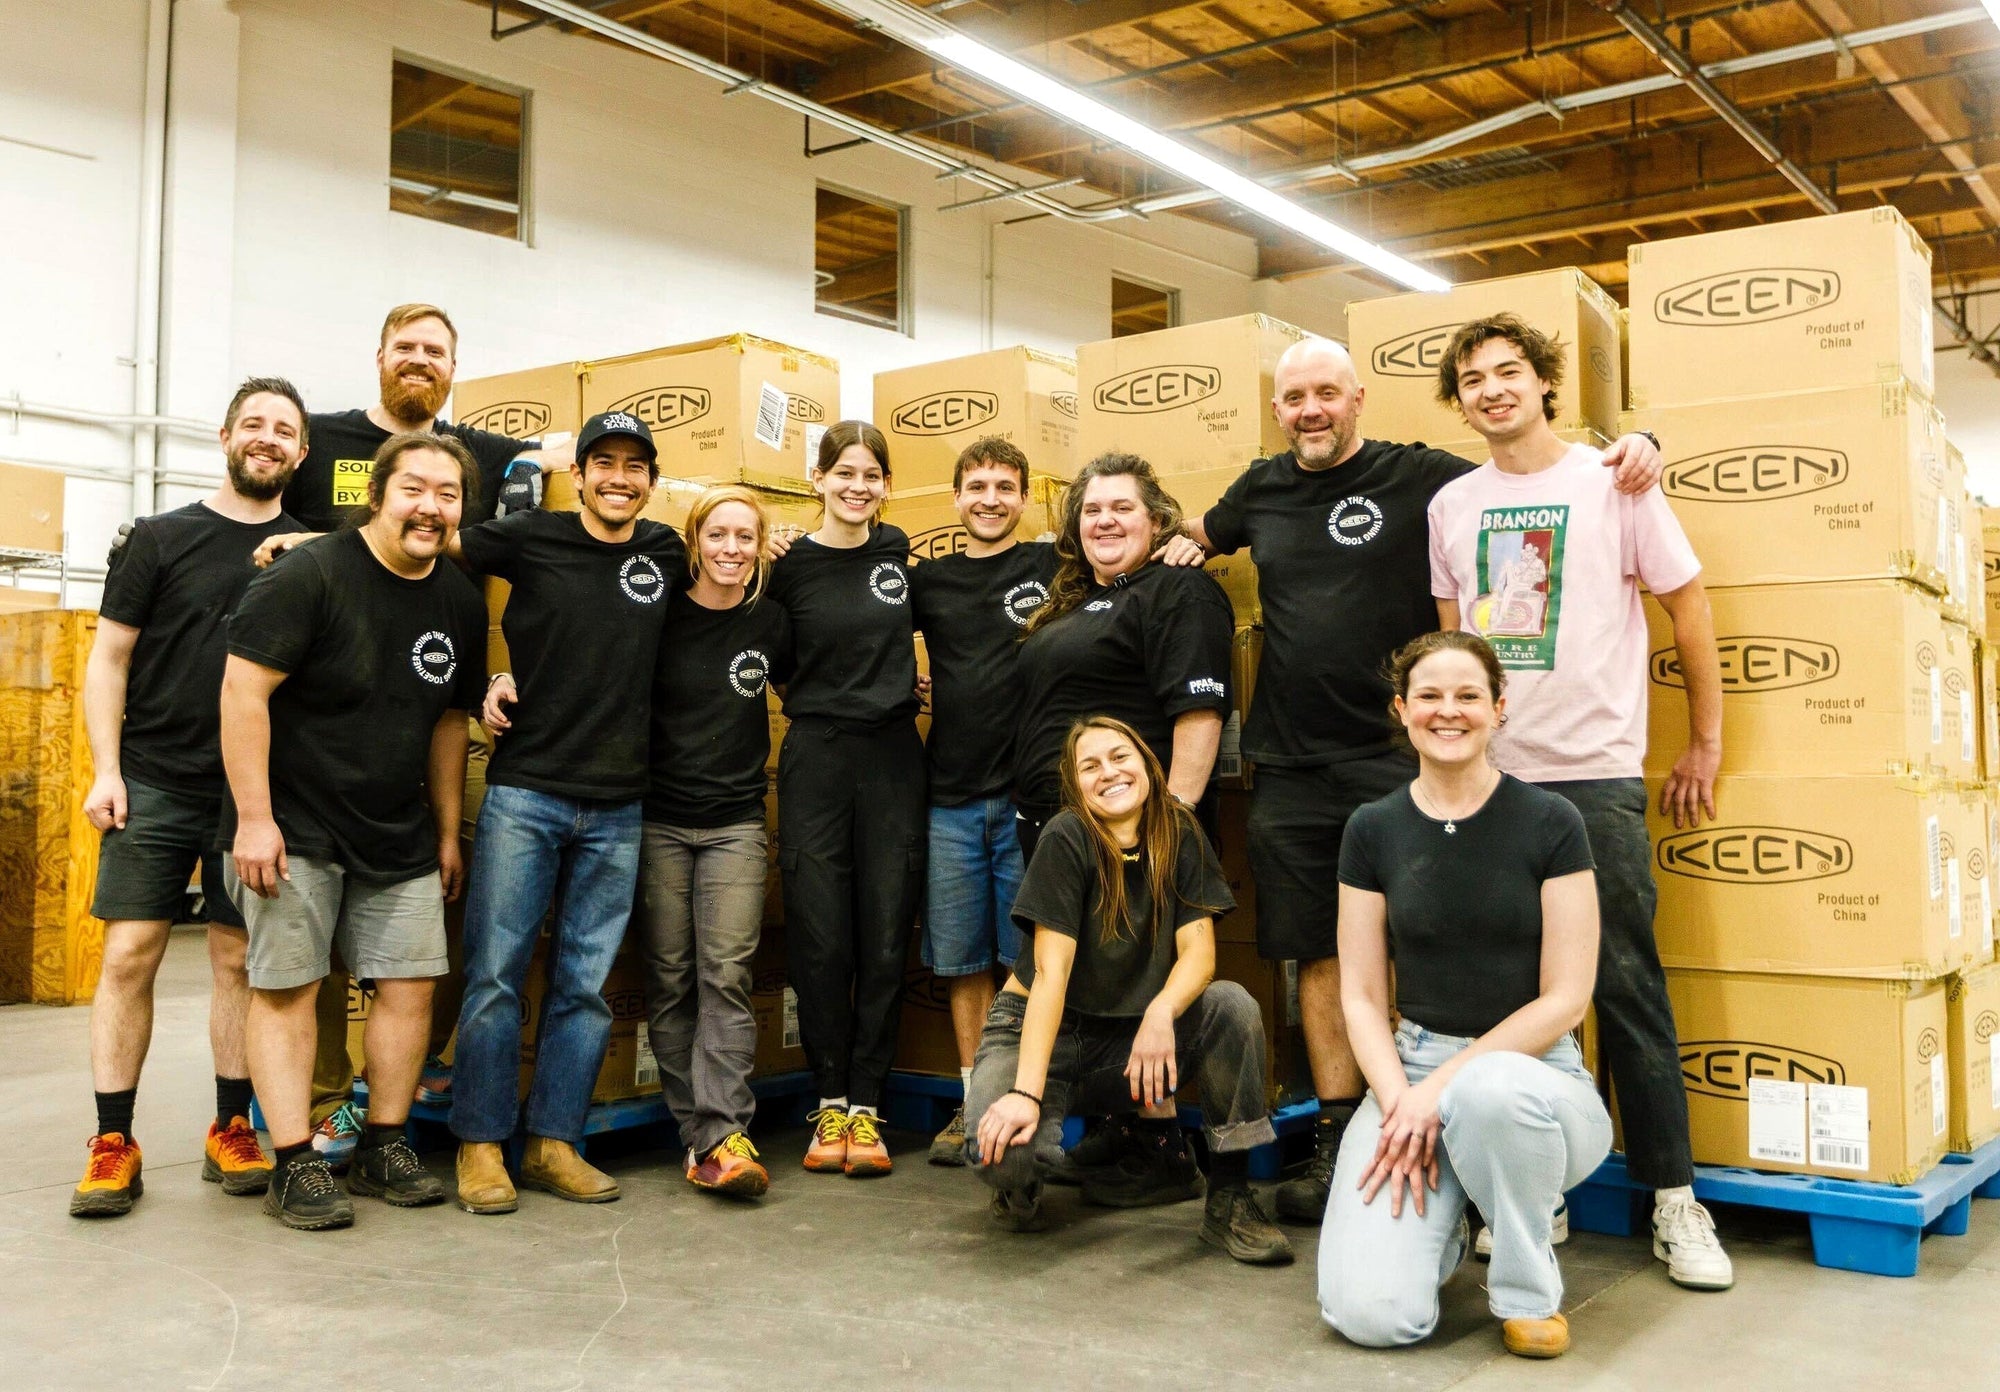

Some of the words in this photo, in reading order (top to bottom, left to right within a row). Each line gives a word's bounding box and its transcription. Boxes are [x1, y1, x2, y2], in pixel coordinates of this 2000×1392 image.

[1663, 277, 1831, 317] KEEN
[1806, 322, 1850, 336] Product
[1854, 320, 1865, 331] of
[1380, 333, 1446, 369] KE
[1820, 337, 1851, 350] China
[1100, 372, 1214, 406] KEEN
[622, 393, 706, 425] EEN
[787, 397, 822, 418] EEN
[896, 398, 993, 429] KEEN
[1052, 395, 1078, 415] KEE
[1197, 410, 1228, 421] Product
[1230, 408, 1238, 418] of
[469, 407, 546, 435] EEN
[1207, 423, 1229, 432] China
[691, 428, 716, 440] Product
[718, 427, 724, 436] of
[700, 441, 717, 451] China
[1669, 454, 1839, 493] KEEN
[337, 491, 361, 502] BY
[1347, 496, 1364, 505] THE
[1328, 500, 1348, 524] DOING
[1363, 499, 1383, 519] RIGHT
[1814, 503, 1858, 515] Product
[1862, 501, 1874, 512] of
[1482, 509, 1564, 530] BRANSON
[1829, 519, 1860, 530] China
[1328, 523, 1364, 545] TOGETHER
[1362, 519, 1383, 541] THING
[909, 532, 968, 560] KEE
[619, 556, 637, 577] DOING
[638, 554, 650, 564] THE
[648, 560, 664, 582] RIGHT
[870, 565, 882, 586] DOING
[880, 563, 893, 571] THE
[620, 578, 652, 603] TOGETHER
[1020, 581, 1034, 590] THE
[1034, 581, 1050, 600] RIGHT
[1004, 605, 1028, 625] GETHER
[412, 632, 433, 654] DOING
[432, 631, 445, 641] THE
[746, 650, 761, 659] THE
[1495, 644, 1538, 652] URE
[412, 655, 443, 684] TOGETHER
[730, 651, 747, 672] DOING
[730, 673, 755, 698] TOGETHER
[1805, 698, 1850, 709] Product
[1854, 697, 1865, 708] of
[1820, 713, 1852, 724] China
[1666, 835, 1842, 874] KEEN
[1818, 893, 1864, 905] Product
[1868, 893, 1879, 905] of
[1833, 909, 1866, 921] China
